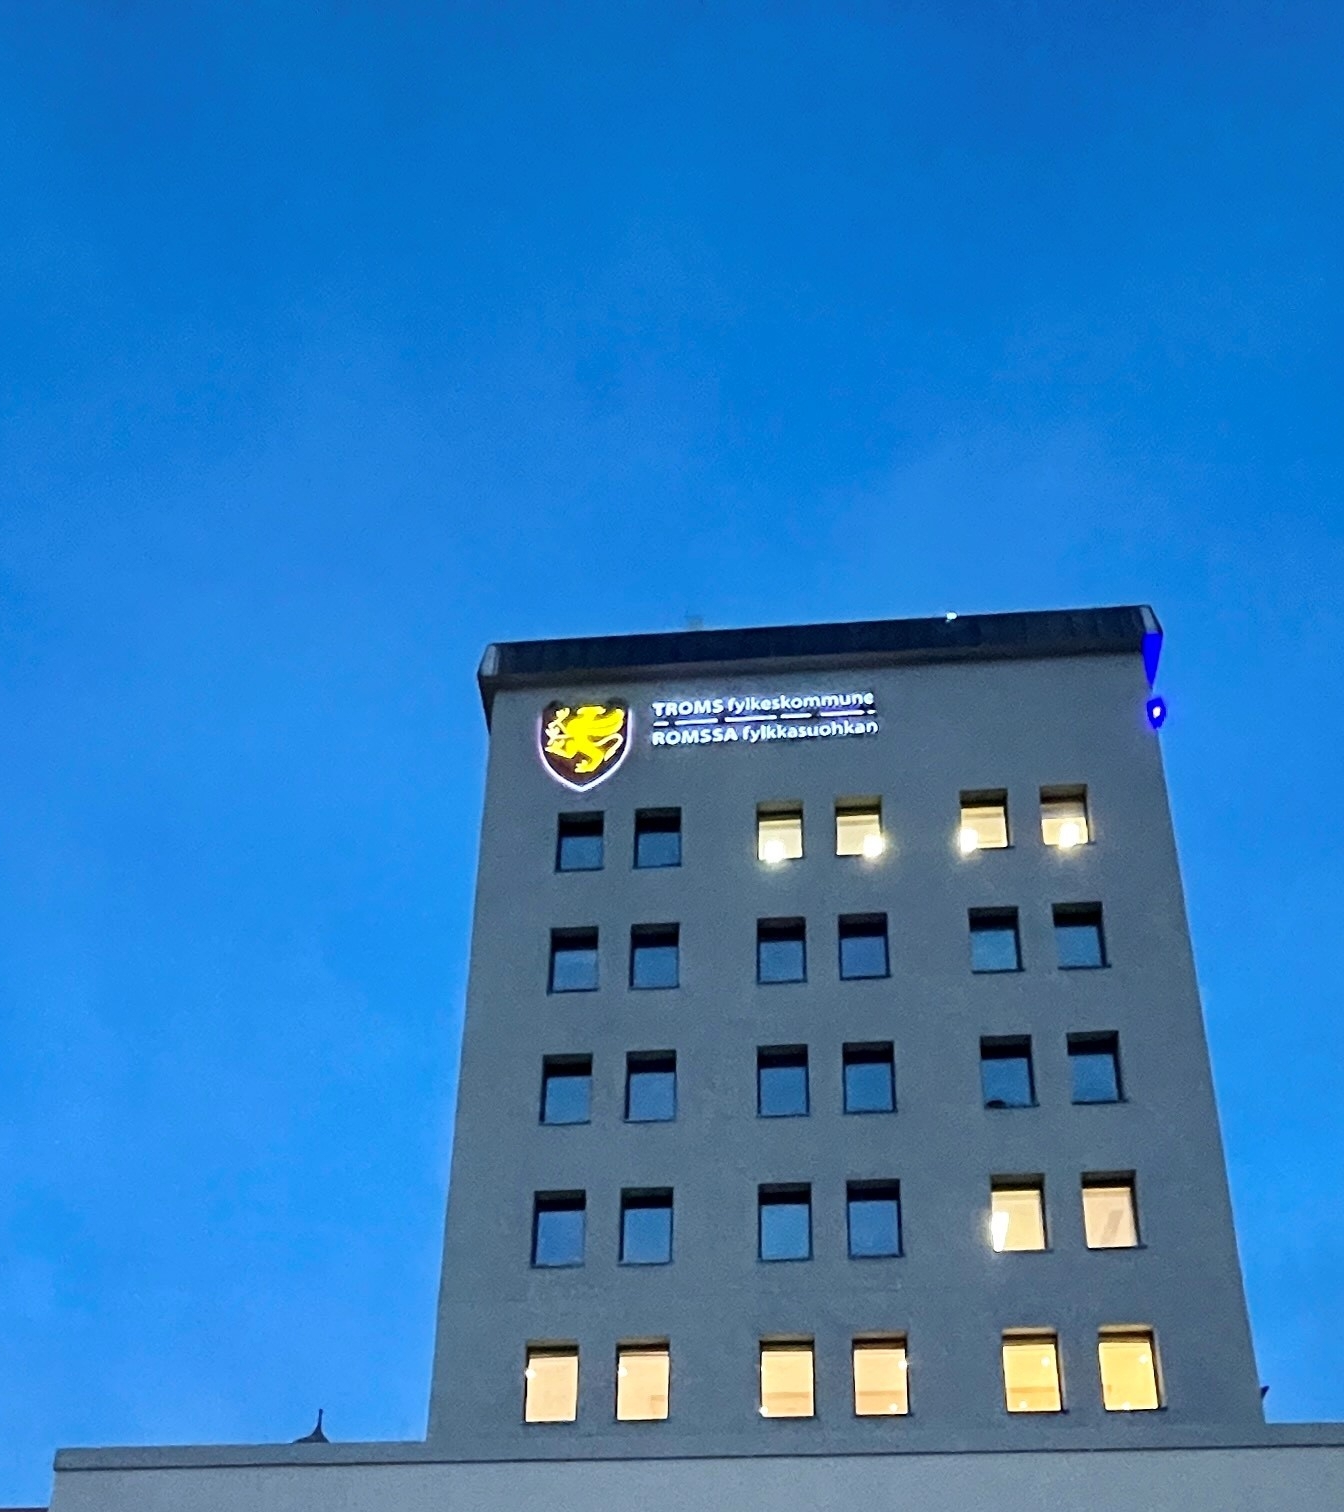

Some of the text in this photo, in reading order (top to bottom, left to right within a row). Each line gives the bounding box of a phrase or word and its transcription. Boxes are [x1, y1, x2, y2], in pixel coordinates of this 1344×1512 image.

[652, 692, 874, 717] TROMS fylkeskommune
[652, 720, 878, 746] ROMSSA fylkkasuohkan
